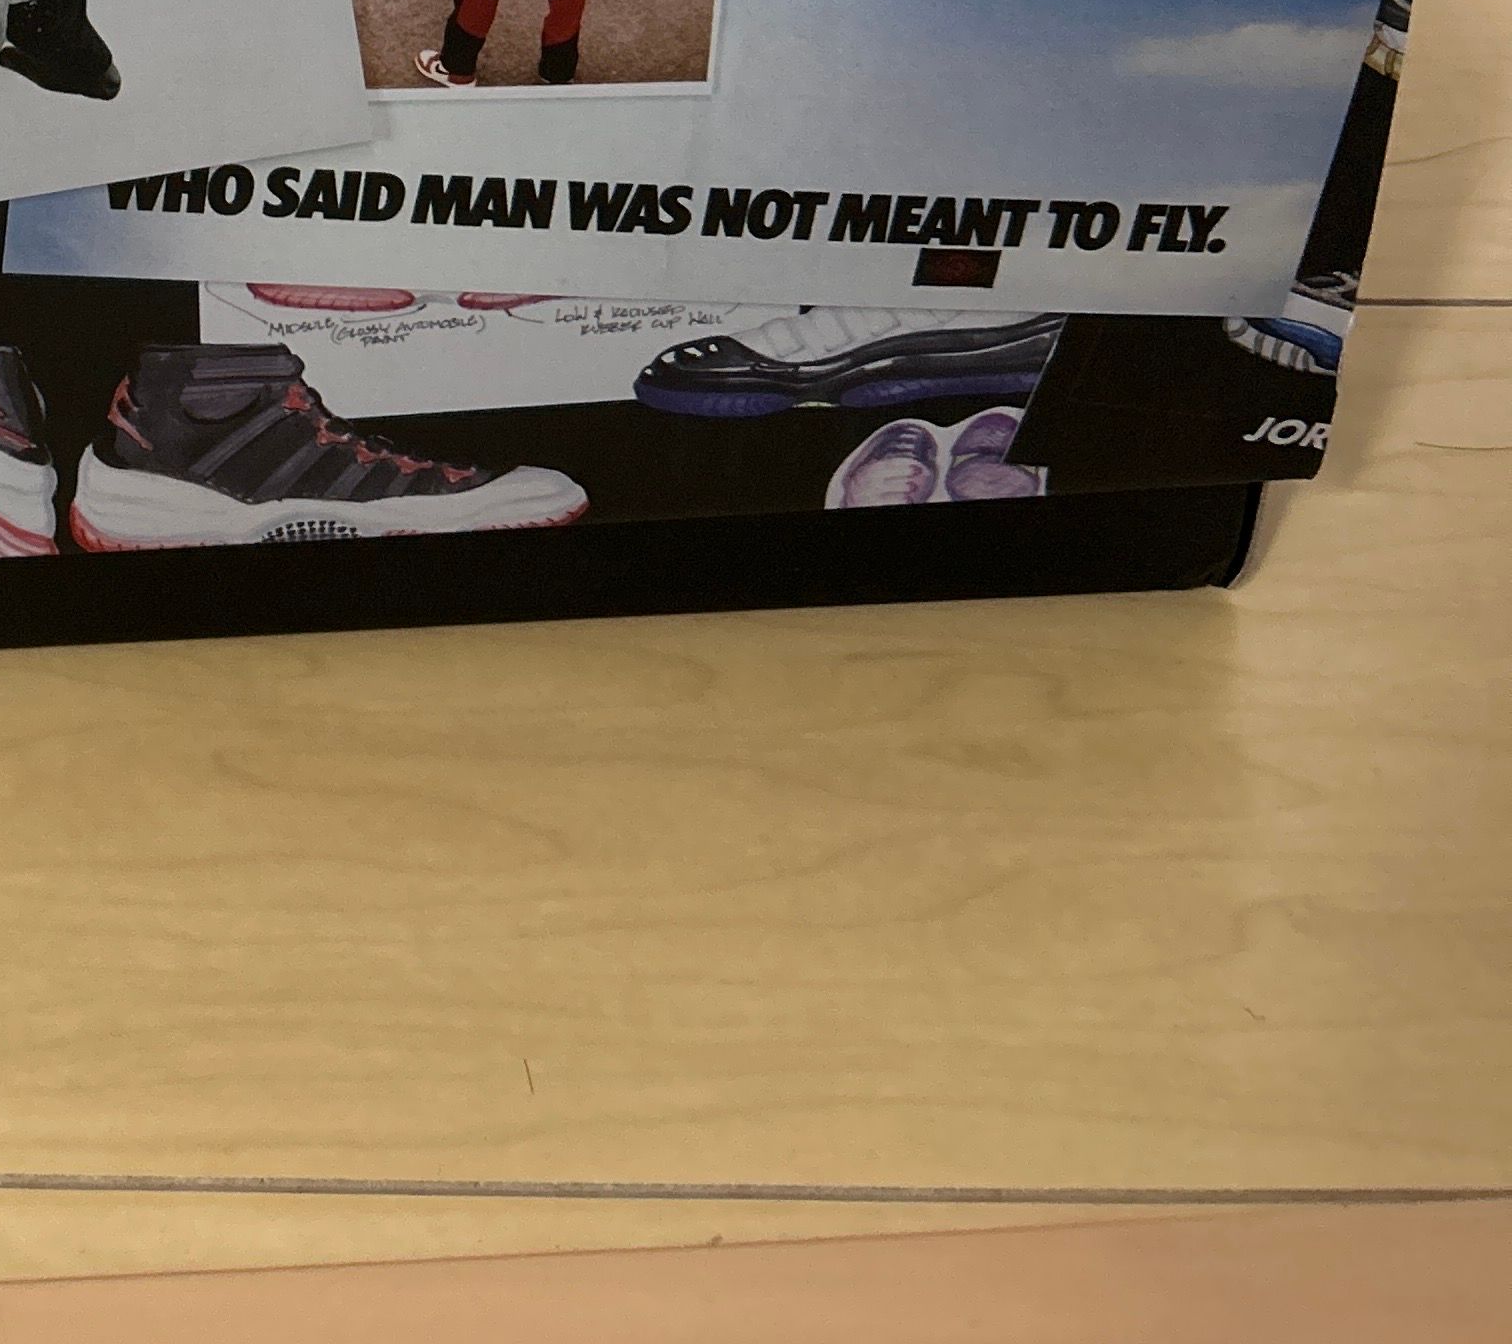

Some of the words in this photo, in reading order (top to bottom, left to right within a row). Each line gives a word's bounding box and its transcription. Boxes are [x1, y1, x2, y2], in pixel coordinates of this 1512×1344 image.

[106, 164, 255, 215] WHO
[262, 166, 407, 221] SAID
[410, 173, 558, 229] MAN
[567, 179, 693, 235] WAS
[701, 187, 830, 241] NOT
[827, 193, 1042, 248] MEANT
[1047, 200, 1122, 252] TO
[1126, 203, 1230, 254] FLY.
[1242, 417, 1332, 450] JOR
